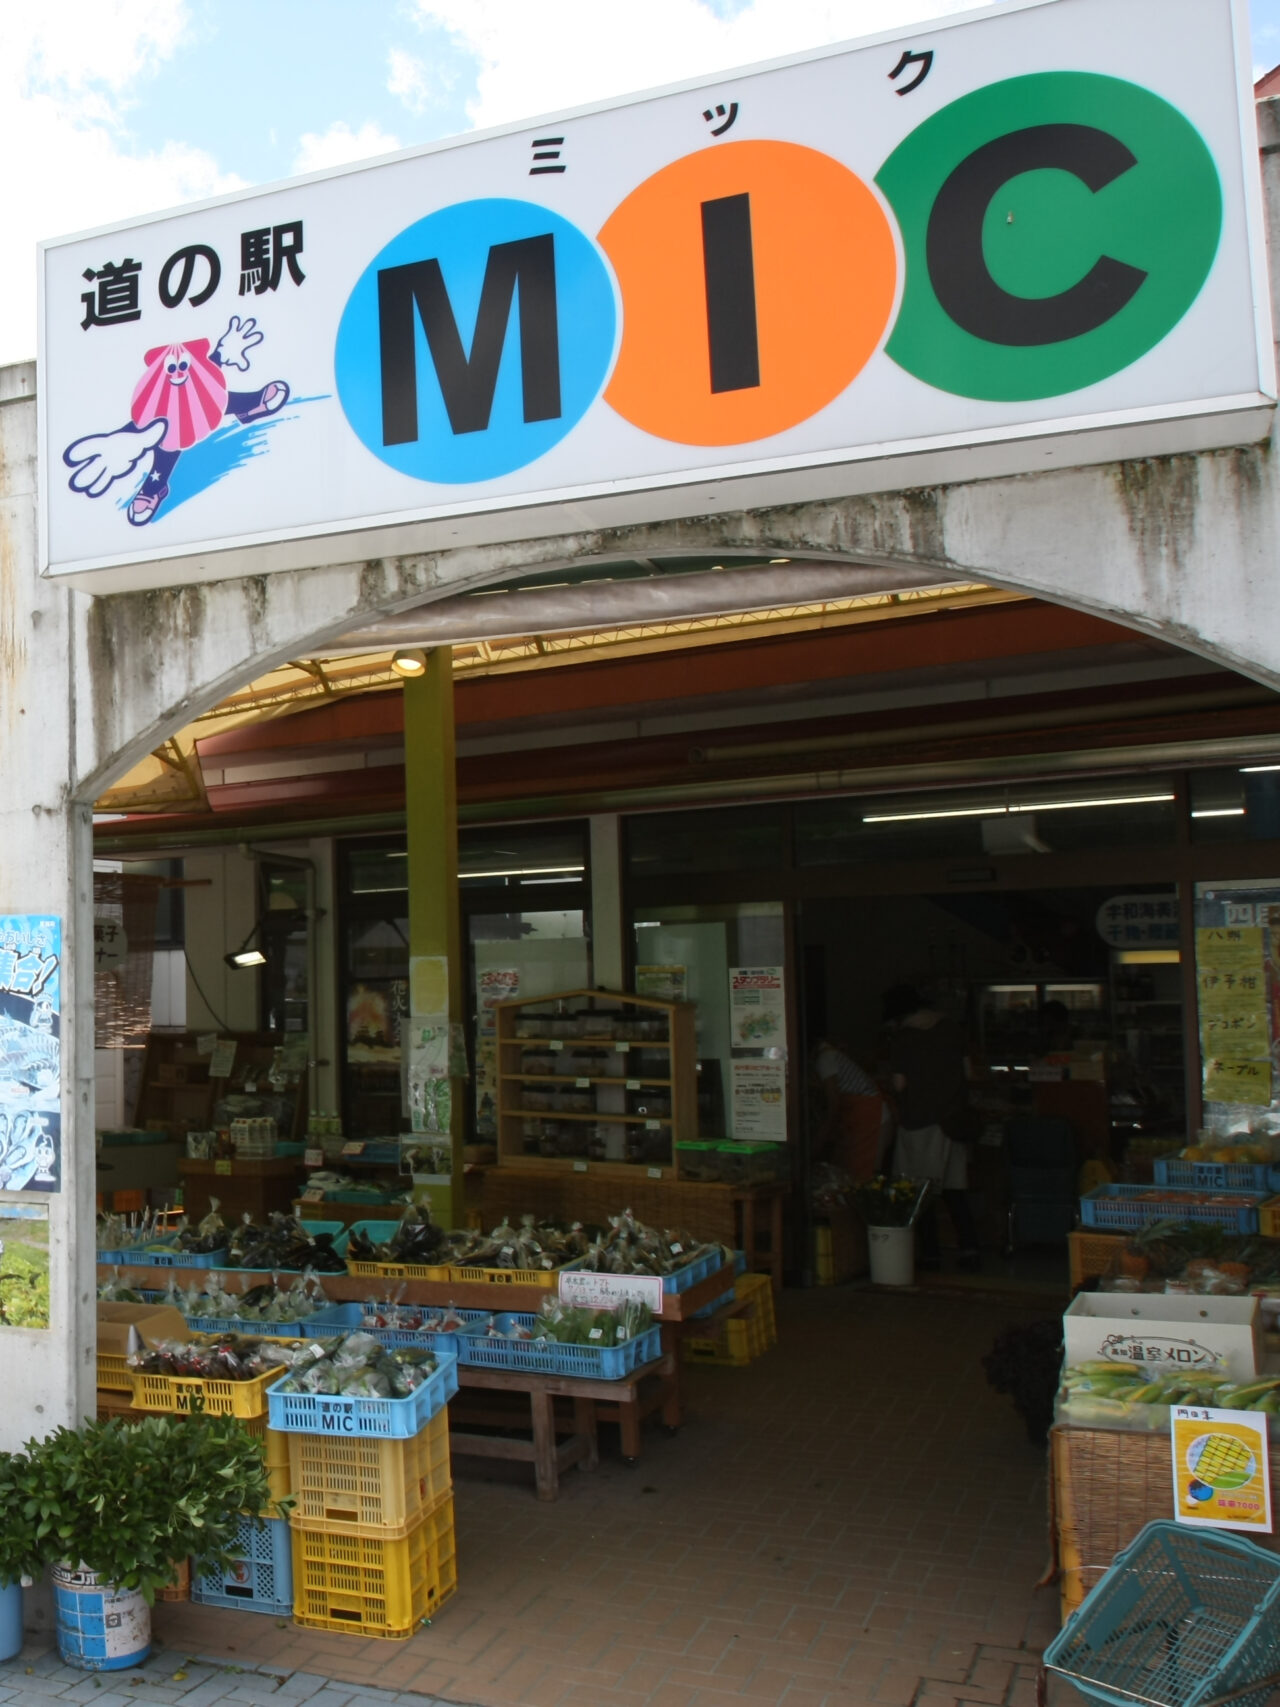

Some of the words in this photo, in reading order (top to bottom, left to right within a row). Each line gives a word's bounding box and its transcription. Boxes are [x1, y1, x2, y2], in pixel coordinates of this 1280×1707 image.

[529, 50, 934, 176] ミック
[80, 220, 306, 331] 道の駅
[377, 123, 1149, 447] MIC
[1203, 975, 1257, 989] 伊予柑
[1213, 1060, 1260, 1076] ネーブル
[1128, 1344, 1207, 1363] 温室メロン
[176, 1395, 204, 1412] MC
[322, 1402, 353, 1414] 道の駅
[322, 1414, 353, 1431] MIC
